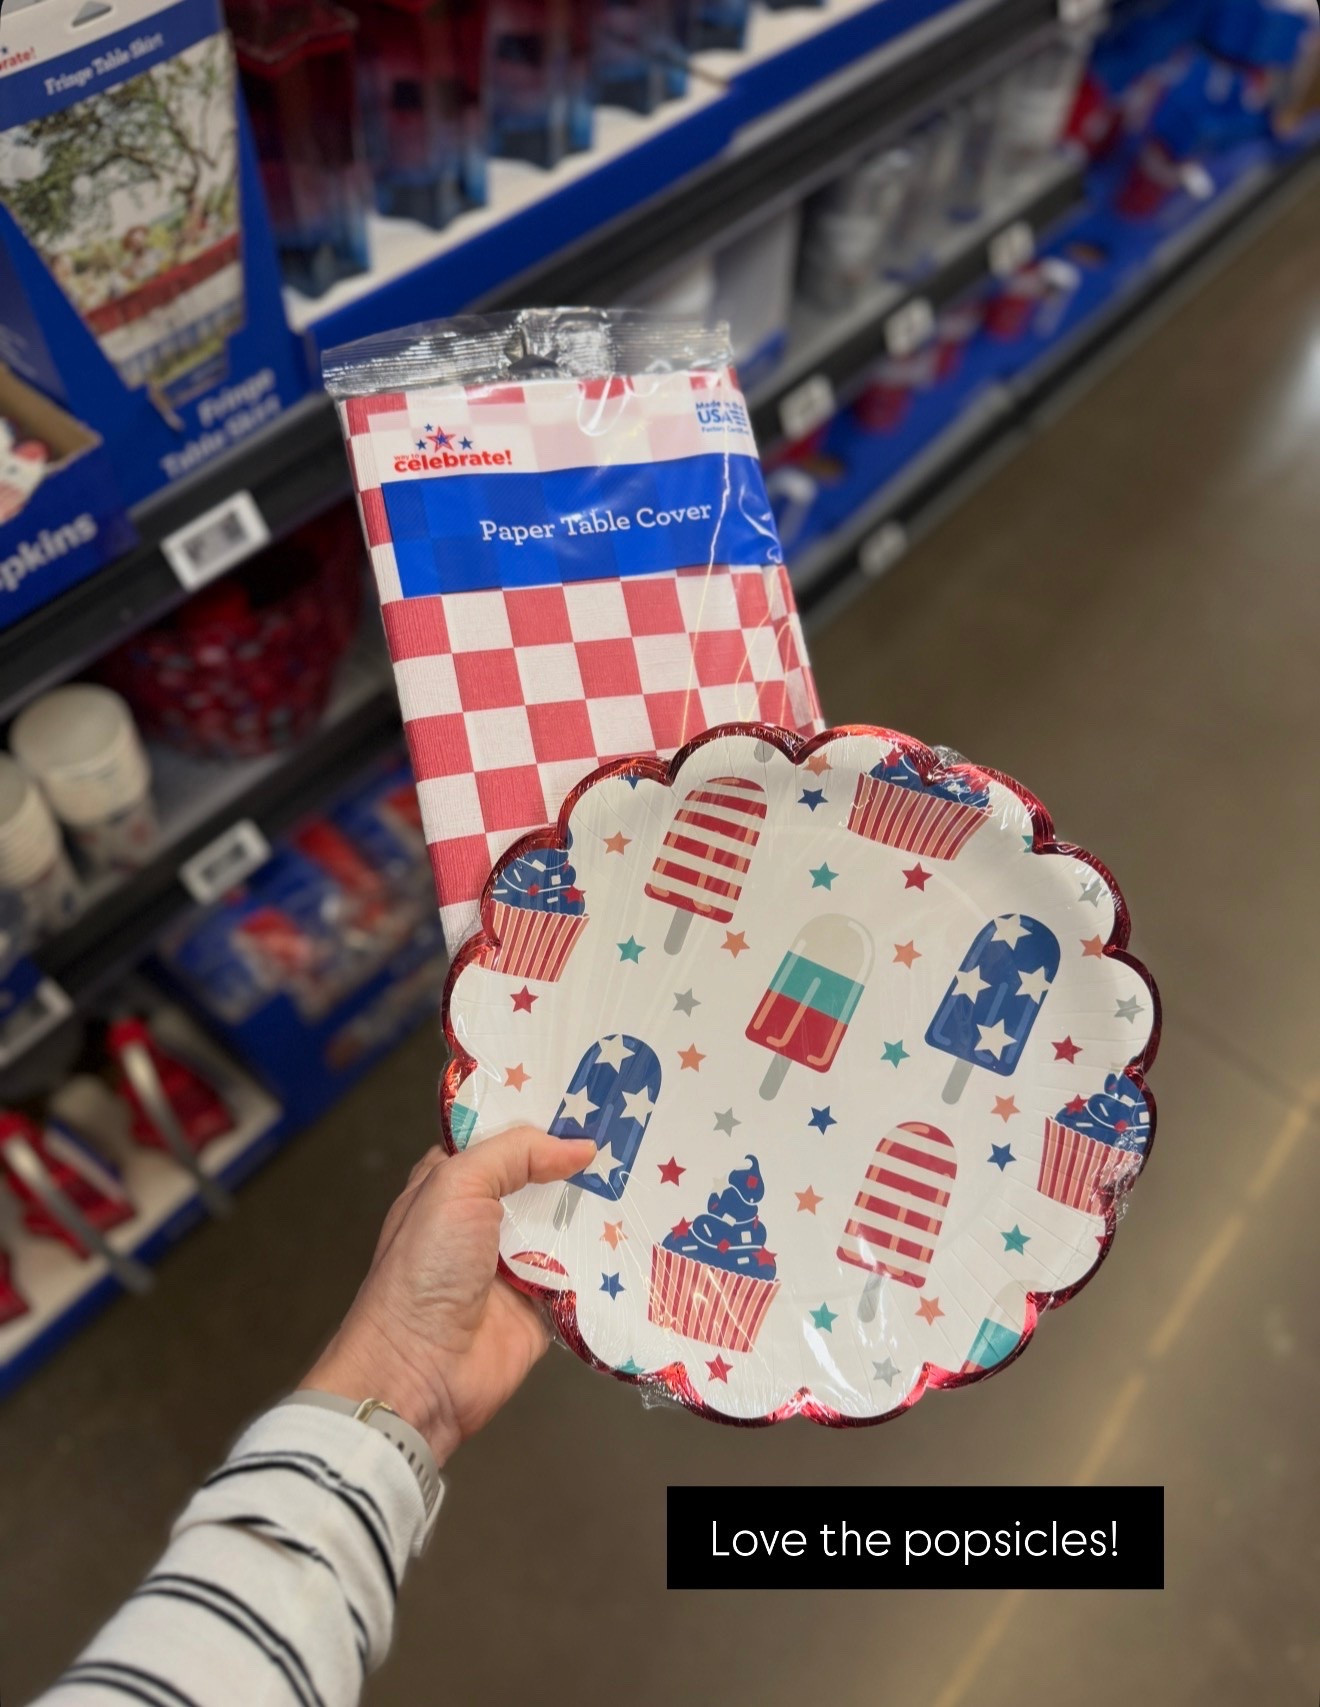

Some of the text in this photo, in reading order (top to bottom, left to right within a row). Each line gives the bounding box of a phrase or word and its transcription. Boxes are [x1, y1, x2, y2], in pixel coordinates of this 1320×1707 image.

[44, 67, 94, 96] Fringe
[91, 48, 131, 75] Table
[697, 409, 733, 424] USA
[394, 450, 513, 472] celebrate!
[480, 504, 711, 545] Paper Table Cover
[0, 512, 98, 592] pkins
